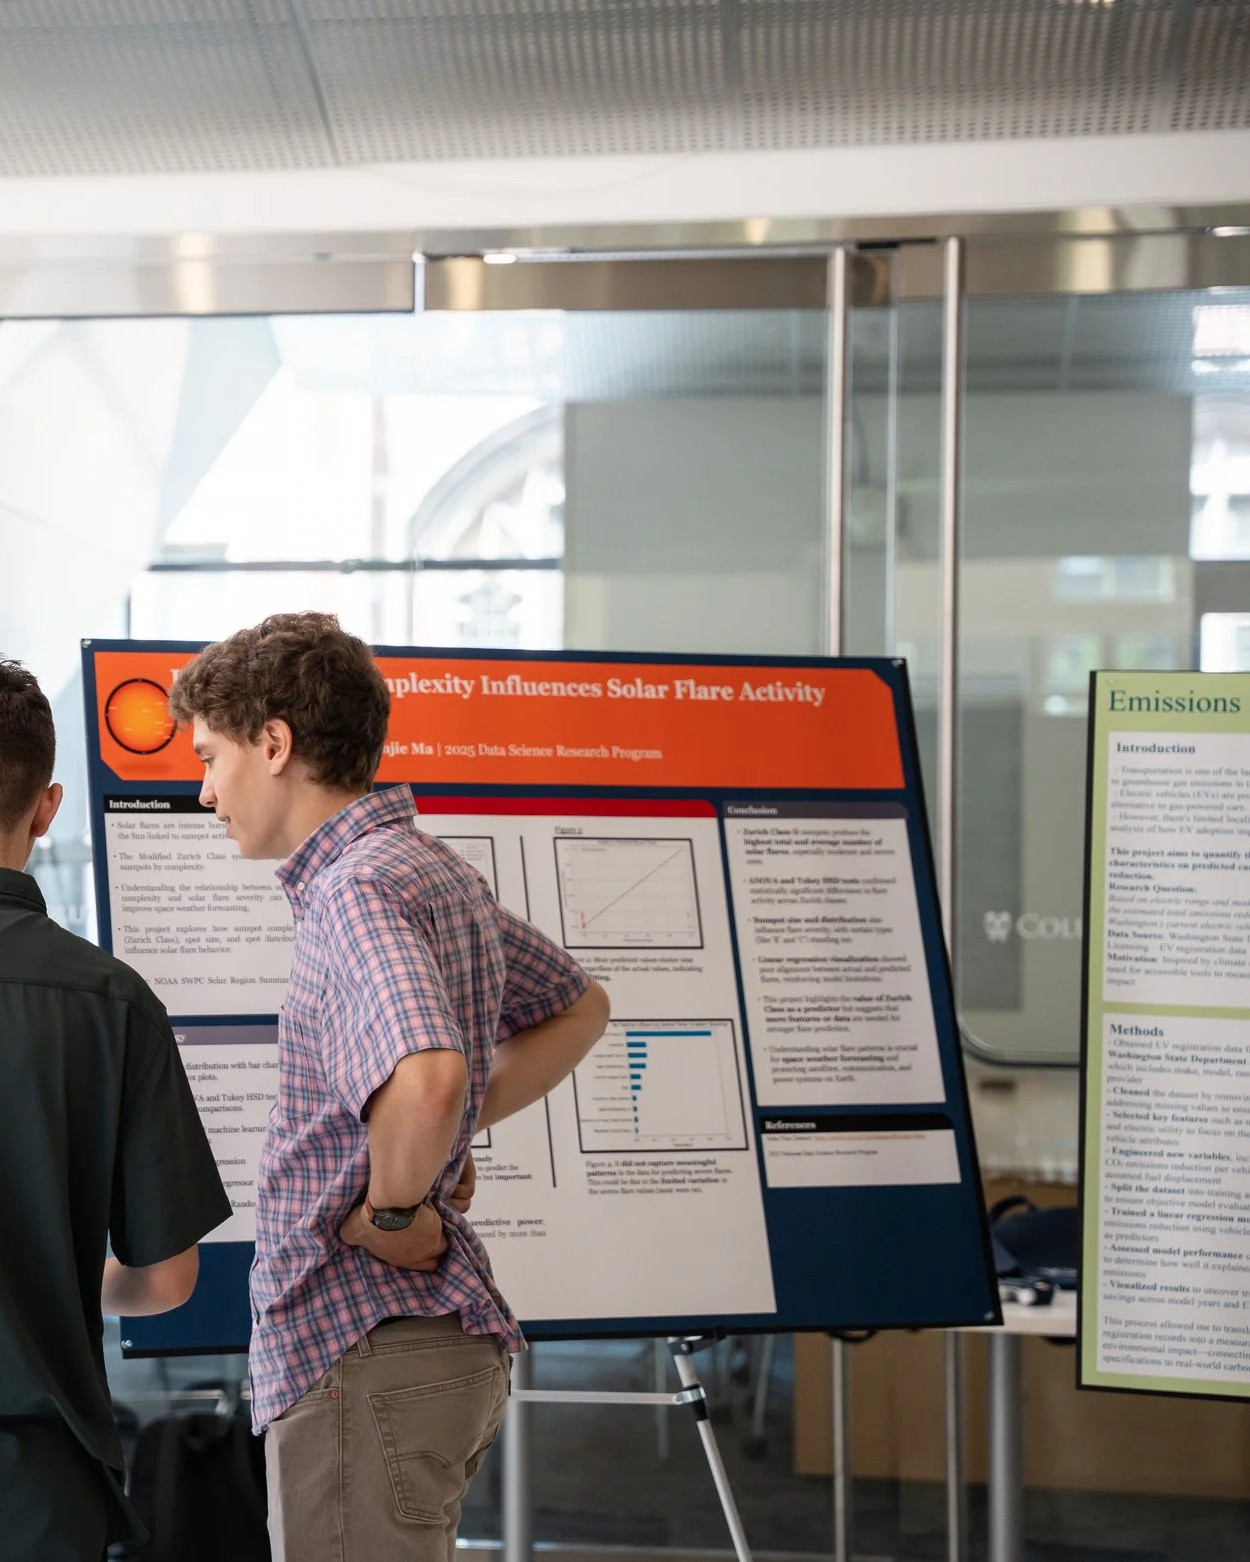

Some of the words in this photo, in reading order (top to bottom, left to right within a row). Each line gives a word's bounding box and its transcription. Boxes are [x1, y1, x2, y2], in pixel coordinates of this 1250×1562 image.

[383, 672, 475, 699] mplexity
[479, 674, 603, 698] Influences
[607, 677, 670, 700] Solar
[674, 678, 735, 701] Flare
[739, 681, 826, 708] Activity
[1108, 689, 1241, 714] Emissions
[382, 741, 408, 758] njie
[412, 743, 434, 756] Ma
[445, 746, 476, 758] 2025
[478, 743, 506, 757] Data
[509, 744, 553, 758] Science
[556, 745, 610, 759] Research
[611, 746, 664, 762] Program
[1116, 742, 1196, 755] Introduction
[109, 800, 171, 810] Introduction
[728, 805, 778, 815] Conclusion
[117, 821, 136, 830] Solar
[139, 821, 160, 830] flares
[178, 821, 205, 830] intense
[118, 832, 129, 840] the
[131, 832, 146, 840] Sun
[147, 832, 170, 840] linked
[181, 833, 210, 842] sunspot
[154, 977, 179, 985] NOAA
[181, 977, 205, 985] SWPC
[208, 977, 227, 985] Solar
[230, 977, 256, 987] Region
[1110, 1023, 1165, 1038] Methods
[1108, 1051, 1162, 1064] Washington
[1165, 1053, 1189, 1063] State
[1191, 1054, 1248, 1067] Department
[765, 1120, 817, 1131] References
